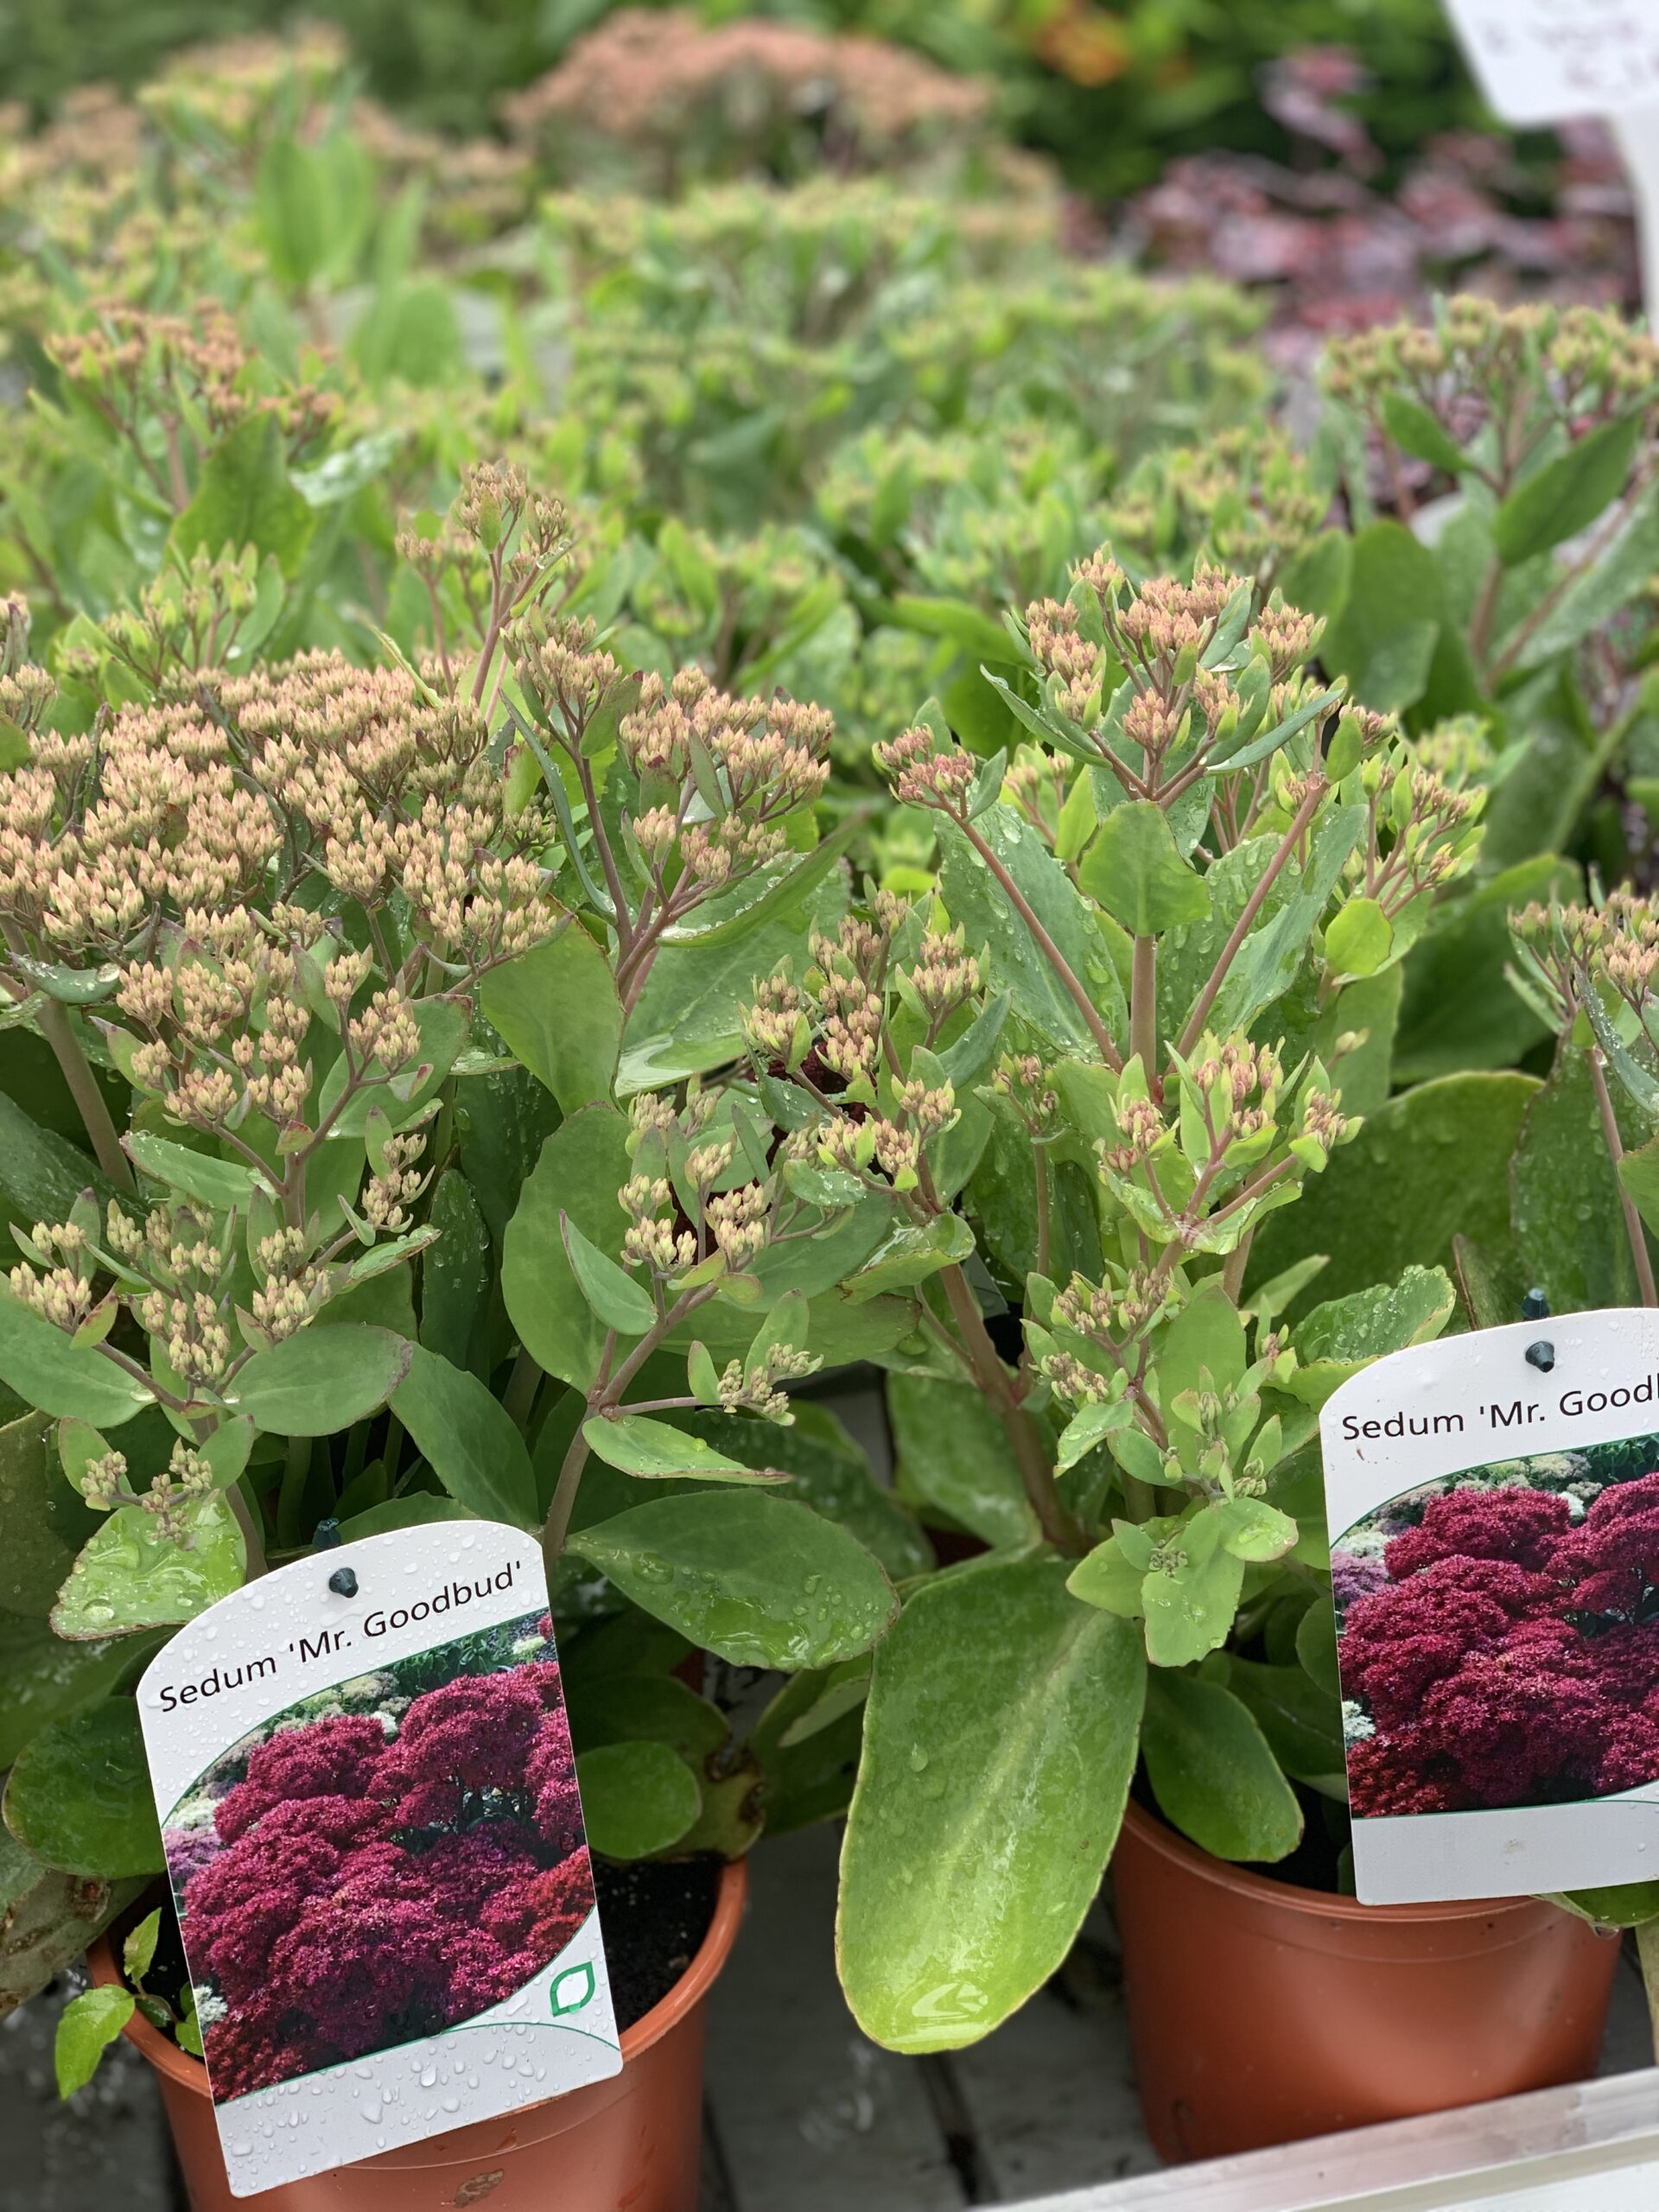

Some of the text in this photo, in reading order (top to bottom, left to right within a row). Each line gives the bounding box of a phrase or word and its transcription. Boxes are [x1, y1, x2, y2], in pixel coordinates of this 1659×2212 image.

[1342, 1372, 1659, 1441] Sedum 'Mr. Good
[159, 1560, 521, 1713] Sedum 'Mr. Goodbud'
